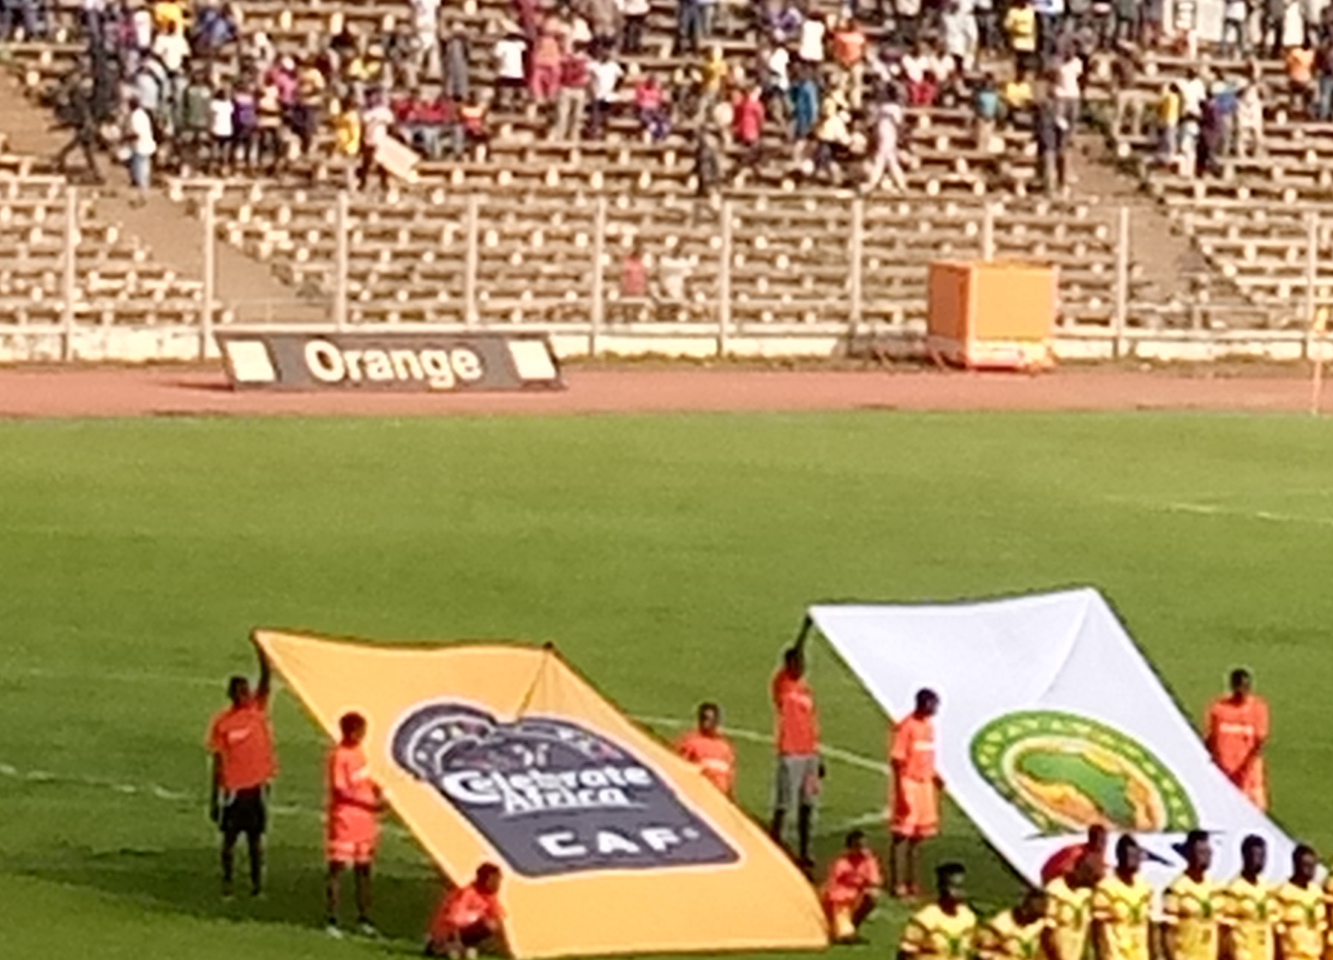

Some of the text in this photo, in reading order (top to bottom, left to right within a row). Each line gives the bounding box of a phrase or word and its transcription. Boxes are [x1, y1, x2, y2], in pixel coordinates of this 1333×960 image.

[305, 339, 483, 389] Orange
[443, 766, 652, 804] Celebrate
[505, 781, 633, 815] Africa
